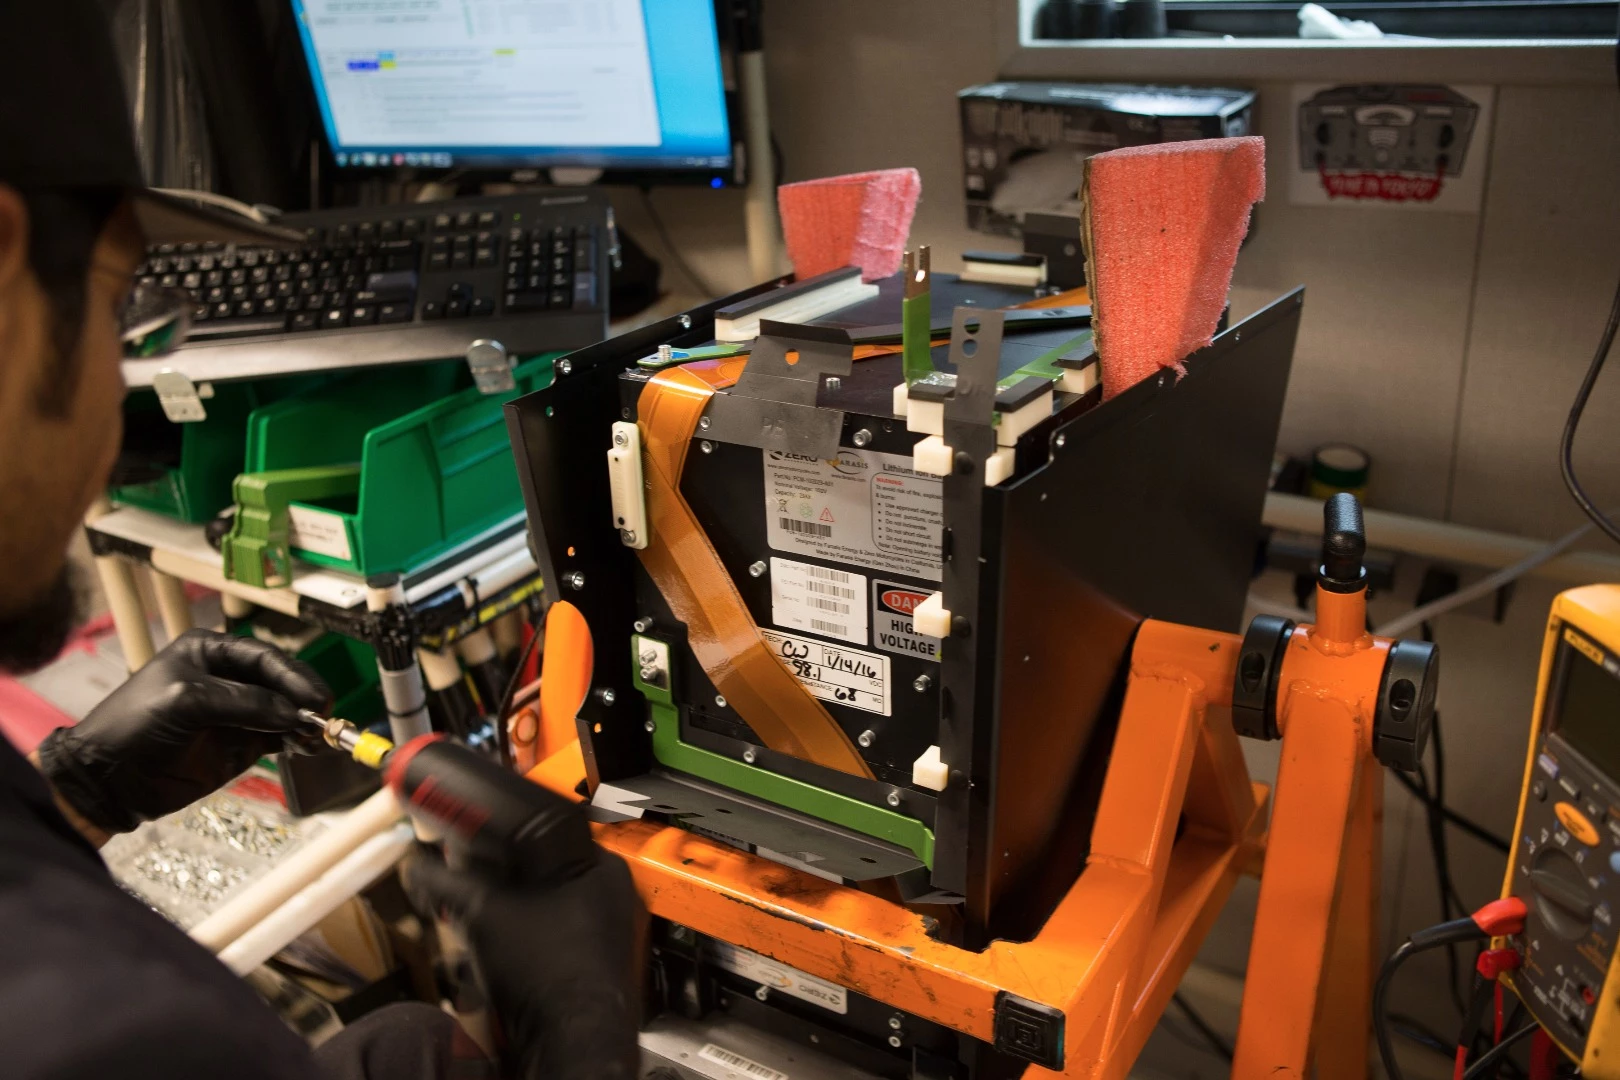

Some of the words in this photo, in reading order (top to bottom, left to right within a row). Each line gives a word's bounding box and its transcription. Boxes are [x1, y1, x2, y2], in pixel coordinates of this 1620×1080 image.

[882, 463, 913, 475] Lithium
[896, 505, 919, 513] approved
[902, 529, 915, 537] short
[891, 543, 913, 554] Opening
[905, 566, 920, 574] China
[890, 593, 923, 611] DAN
[891, 619, 924, 637] HIG
[880, 632, 935, 657] VOLTAGE
[828, 655, 877, 679] 1/14/16
[834, 687, 856, 702] 68
